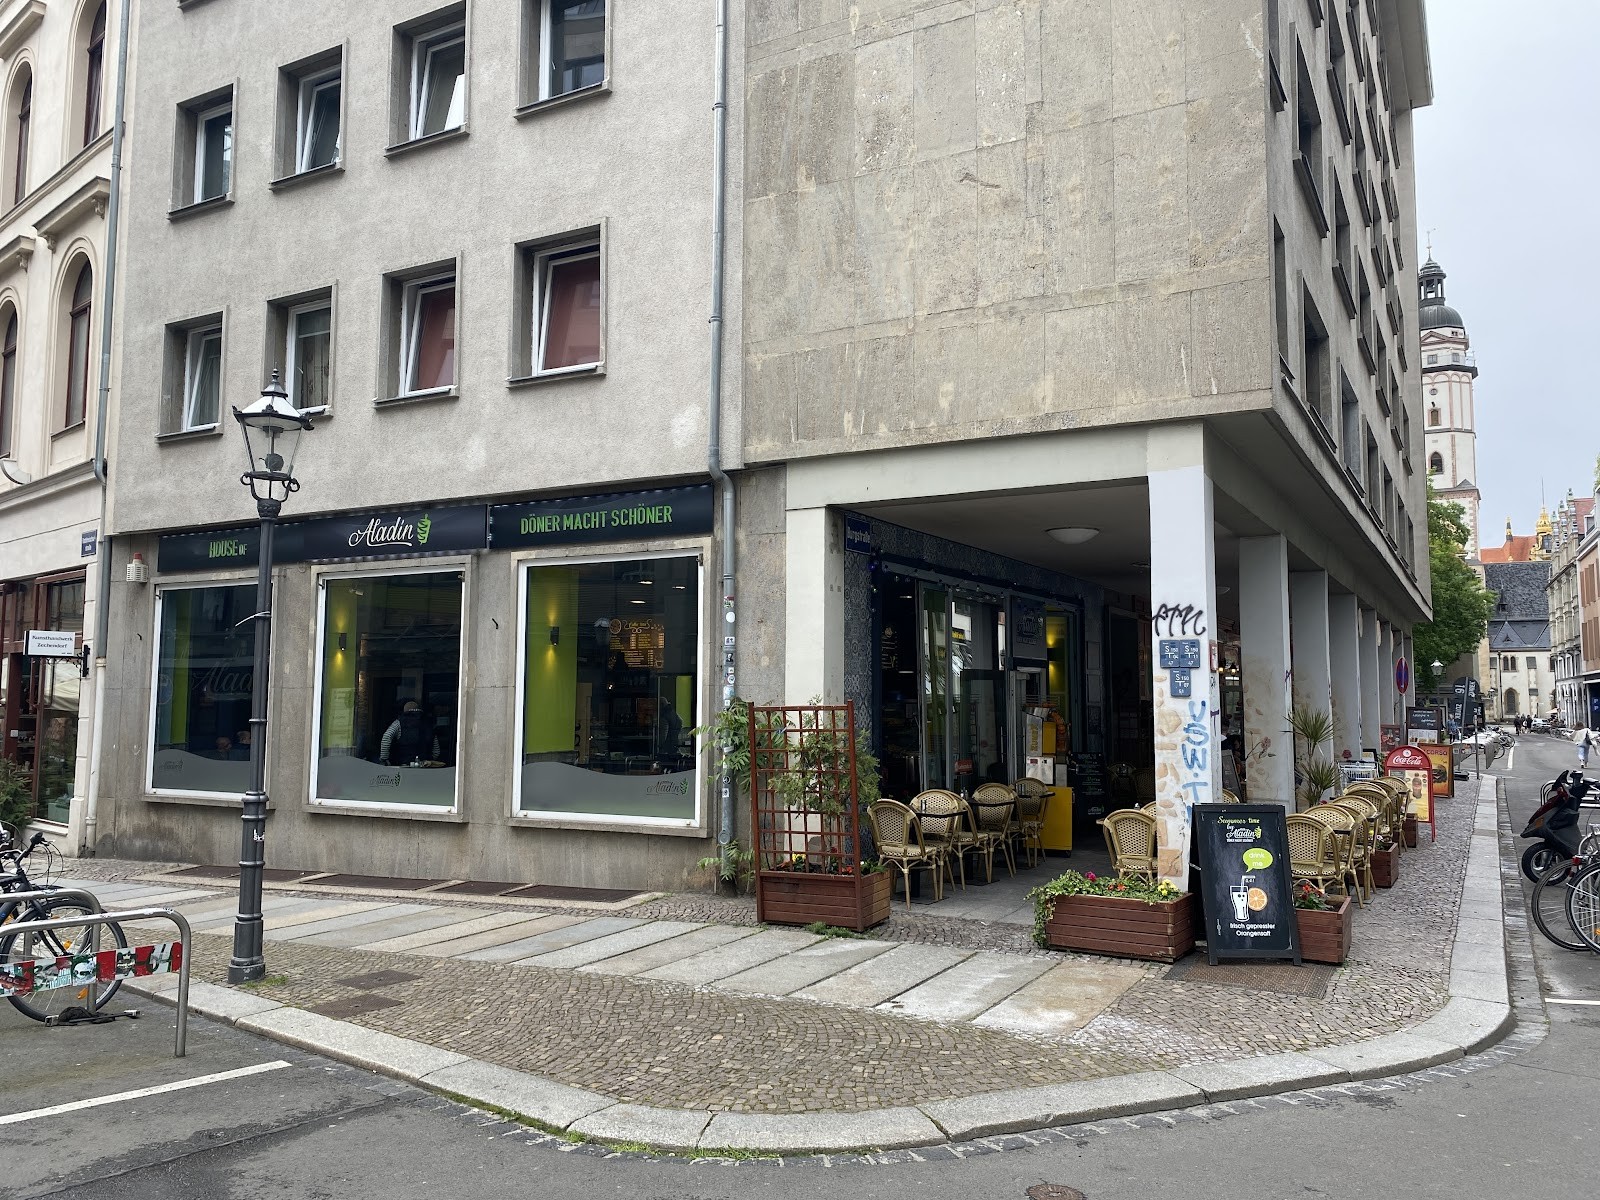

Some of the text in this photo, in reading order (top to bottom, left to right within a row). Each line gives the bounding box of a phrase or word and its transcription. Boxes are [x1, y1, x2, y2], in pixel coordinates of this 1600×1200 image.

[348, 516, 414, 547] Aladin
[520, 503, 673, 535] DÖNER MACHT SCHÖNER
[208, 539, 248, 558] HOUSE OF
[1392, 755, 1423, 766] Coca-Cola
